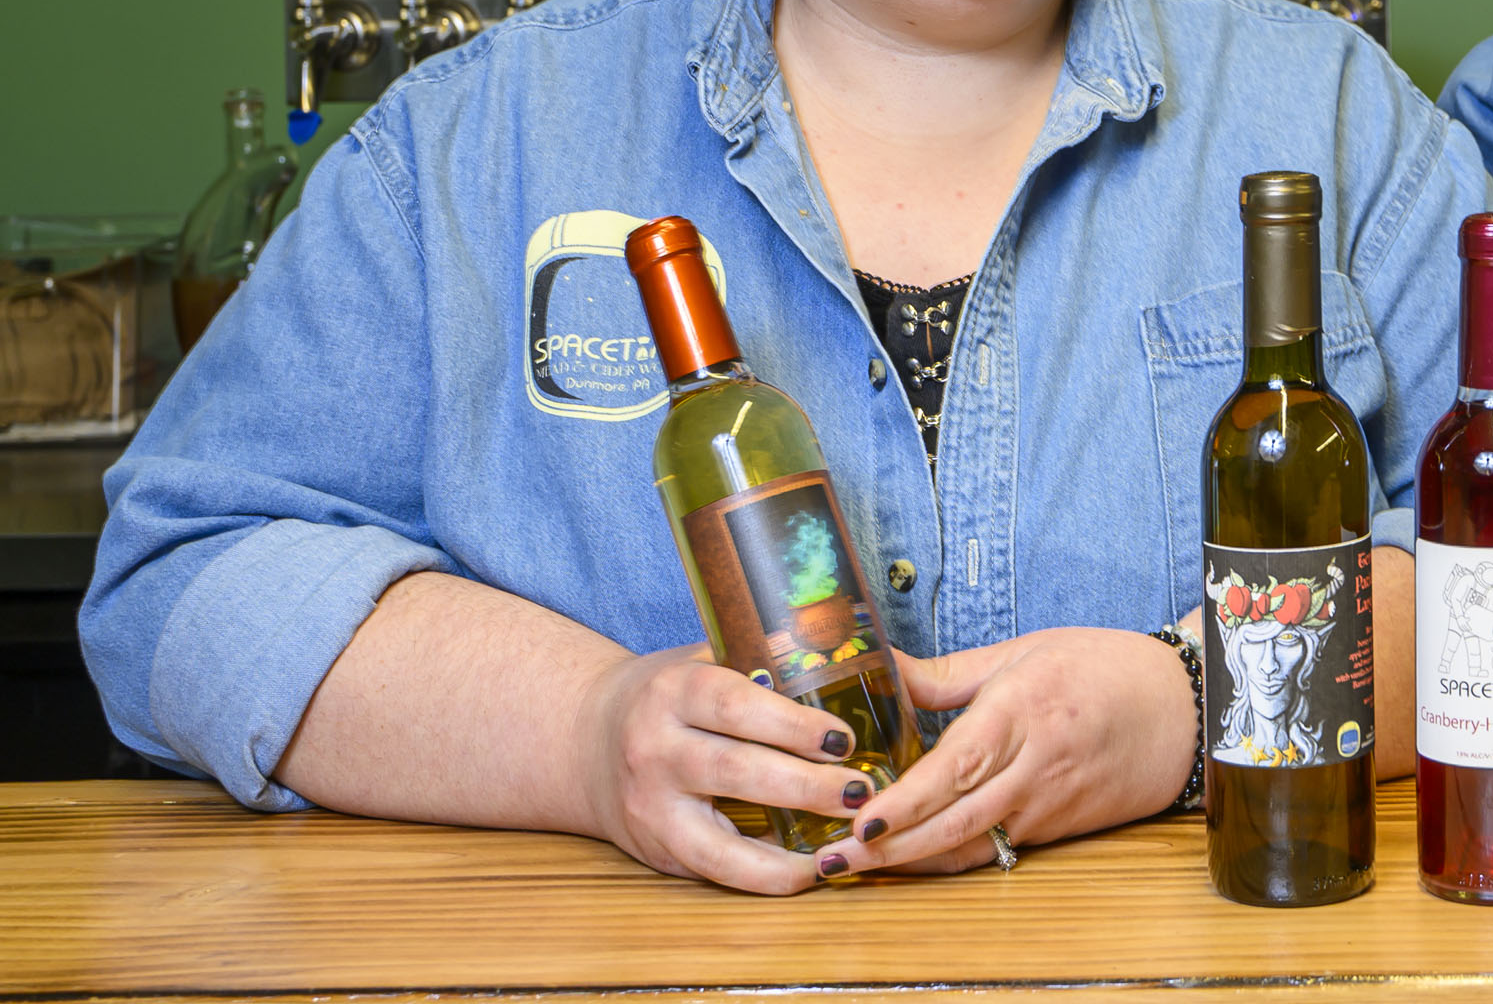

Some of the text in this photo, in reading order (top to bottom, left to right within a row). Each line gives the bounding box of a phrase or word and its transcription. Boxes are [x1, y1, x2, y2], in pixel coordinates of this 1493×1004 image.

[534, 334, 657, 364] SPACETI
[590, 363, 635, 377] CIDER
[632, 378, 650, 391] PA
